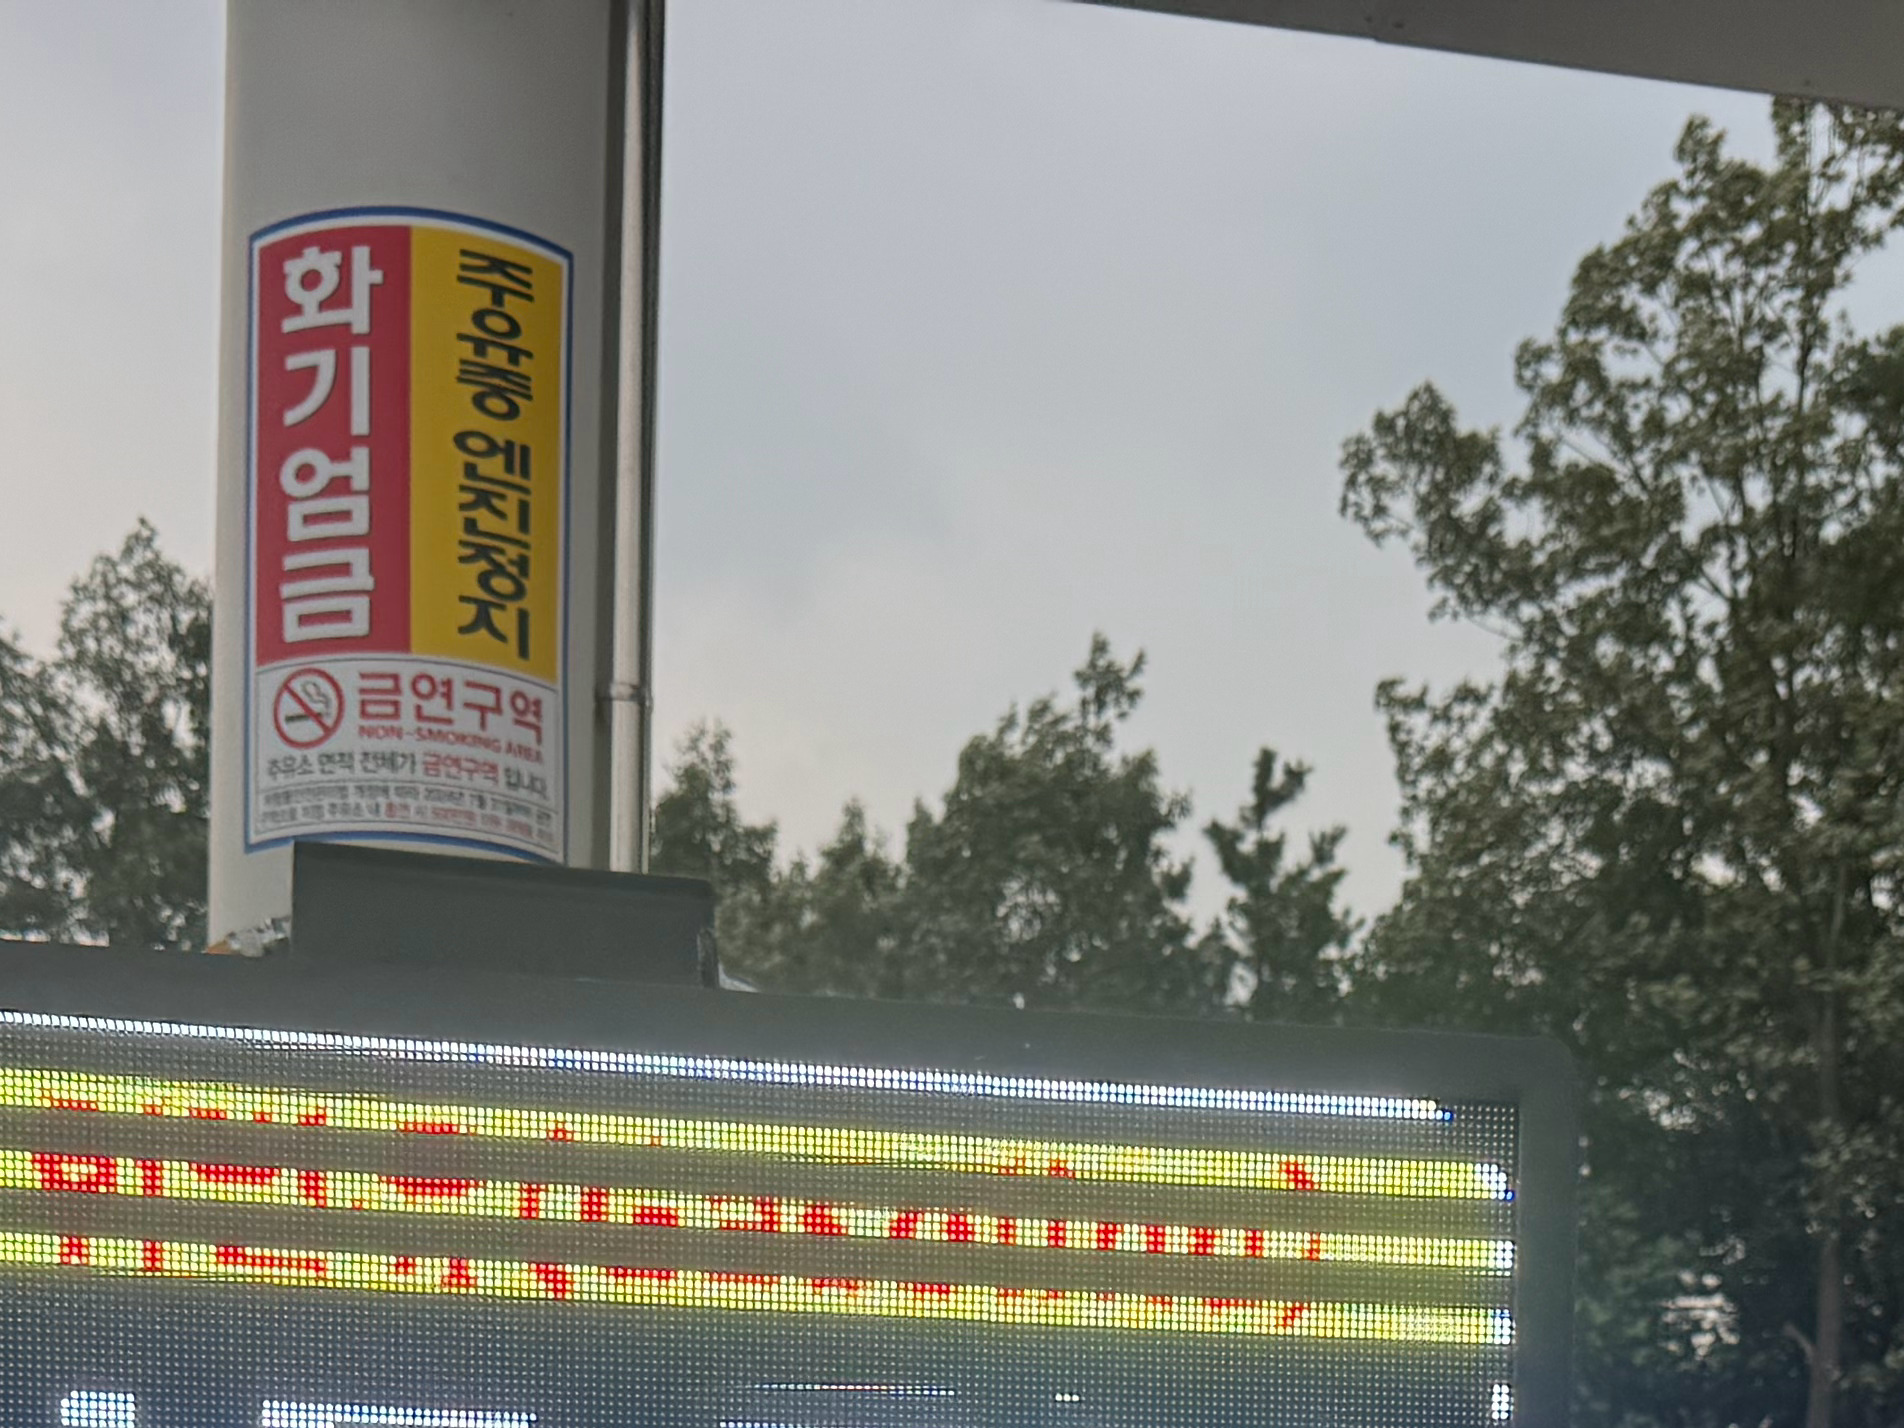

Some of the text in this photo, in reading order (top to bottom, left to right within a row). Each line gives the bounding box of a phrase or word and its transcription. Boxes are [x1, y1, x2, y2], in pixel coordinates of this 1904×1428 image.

[278, 244, 384, 644] 화기엄금
[453, 429, 532, 661] 엔진정지
[358, 671, 543, 746] 금연구역
